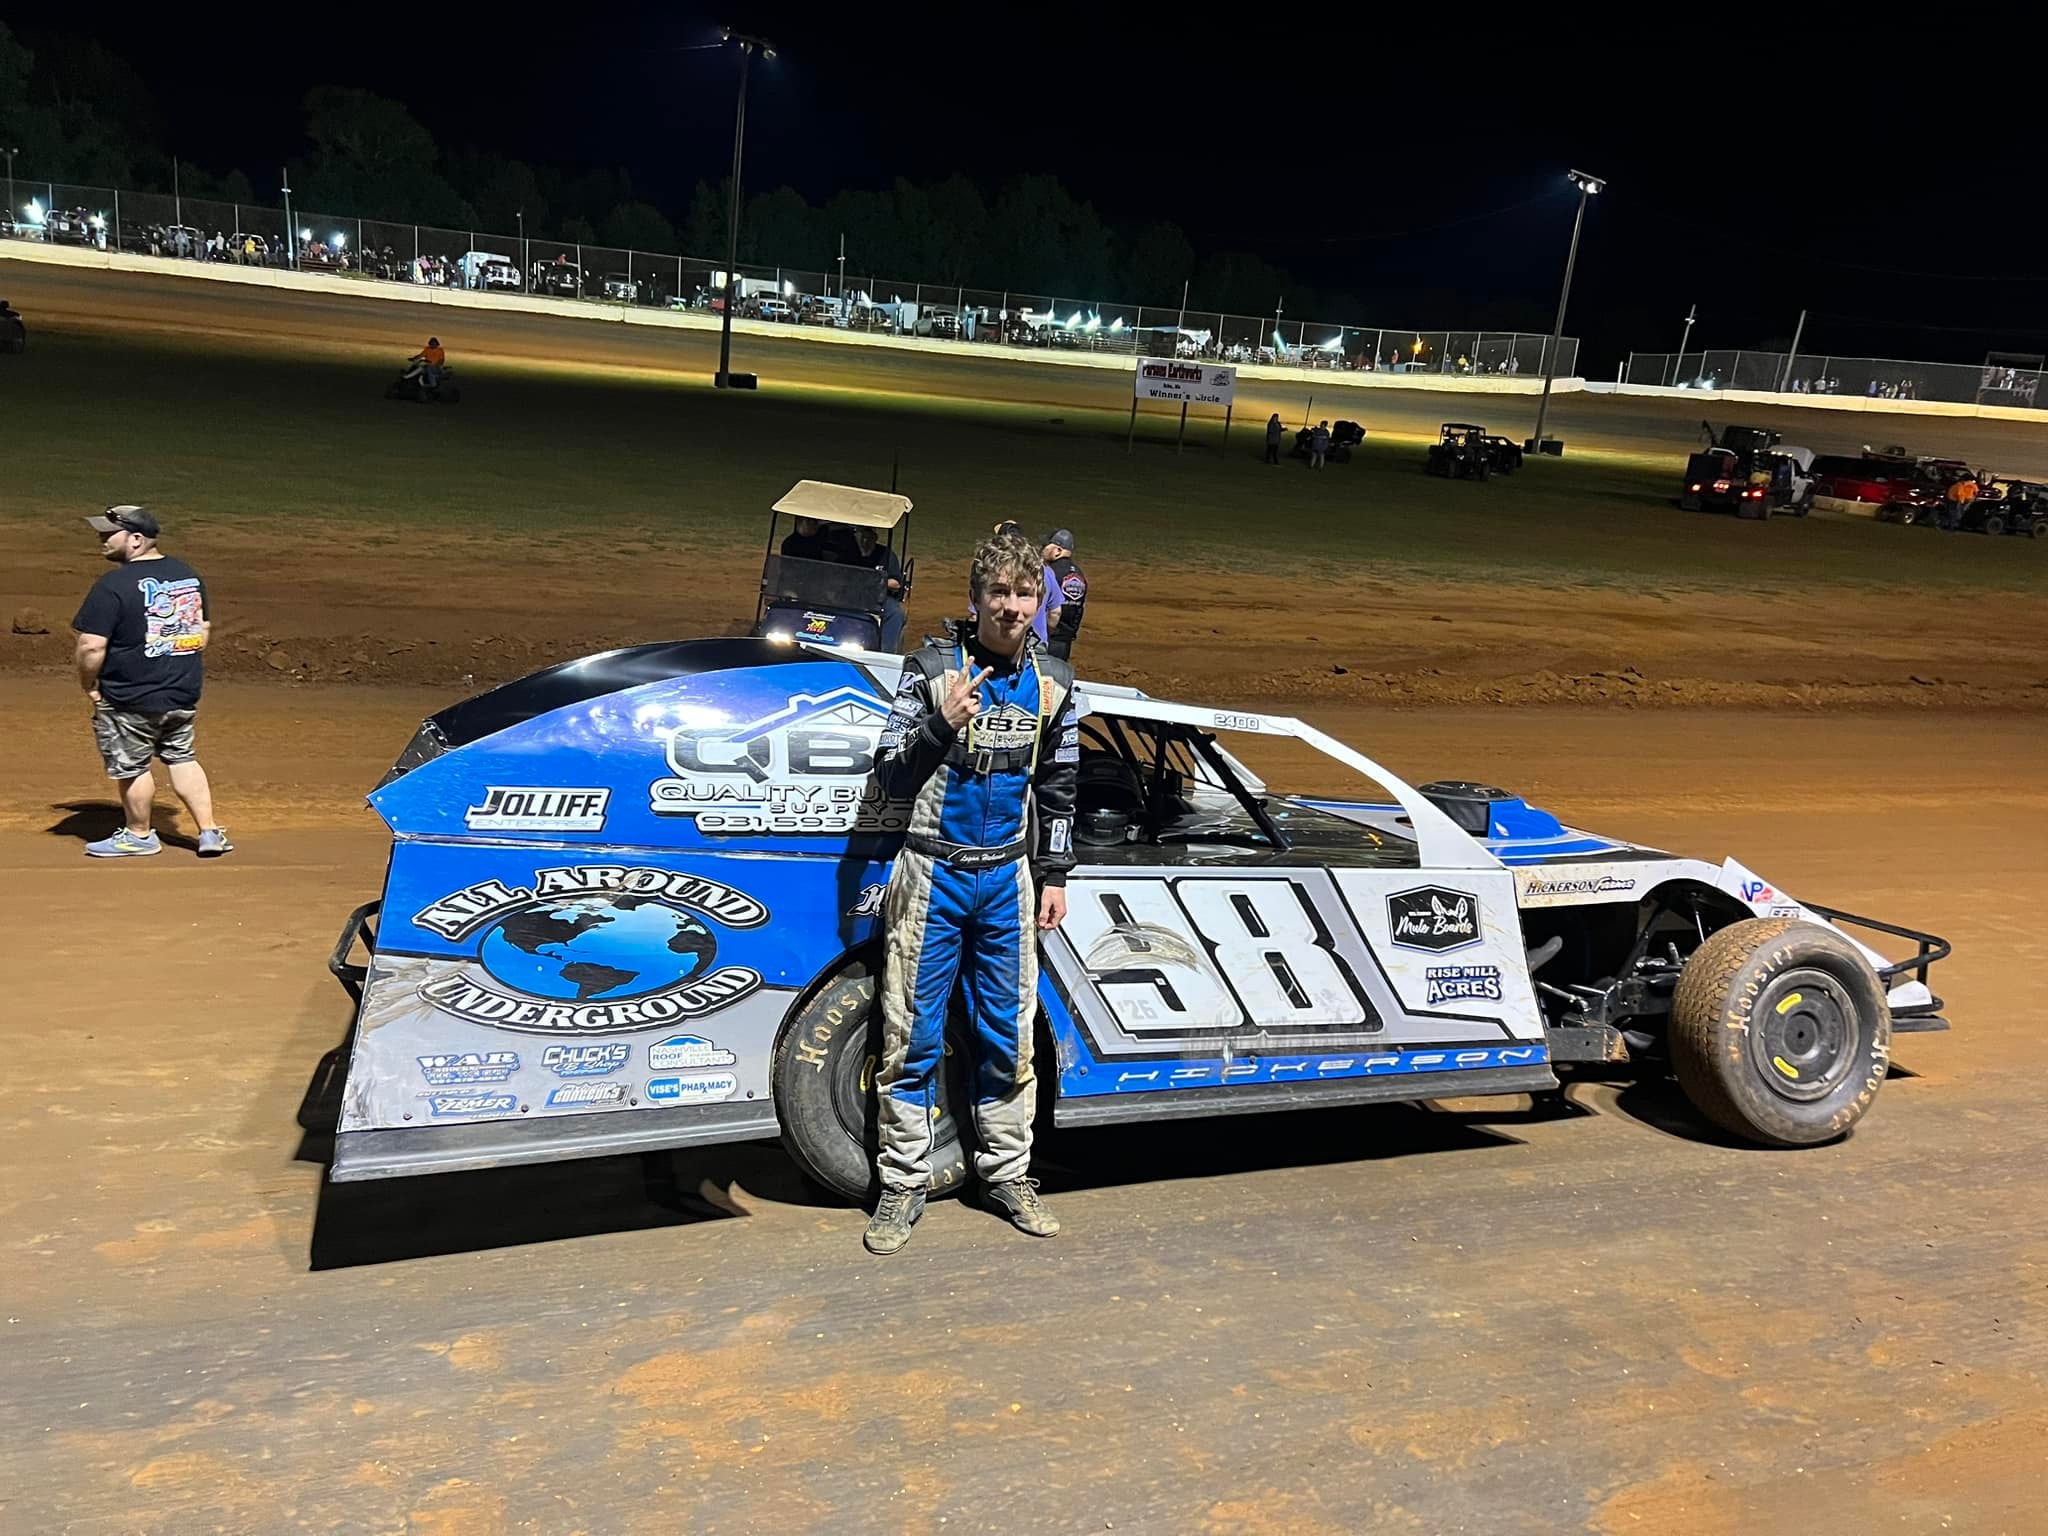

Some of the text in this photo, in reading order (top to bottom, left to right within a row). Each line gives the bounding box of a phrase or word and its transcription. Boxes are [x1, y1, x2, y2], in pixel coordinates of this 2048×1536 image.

[1149, 388, 1191, 401] Winner's
[1214, 713, 1259, 730] 2400
[674, 728, 876, 784] QB
[470, 790, 602, 817] JOLLIFF
[656, 783, 881, 803] QUALITY BU
[769, 802, 887, 815] SUPPLY
[700, 815, 905, 831] 931-593-20
[1742, 881, 1763, 902] VP
[418, 867, 764, 938] ALL AROUND
[1395, 915, 1473, 936] Mule Boards
[1427, 966, 1498, 979] RISE MILL
[430, 967, 758, 1029] UNDERGROUND
[1427, 976, 1500, 1002] ACRES
[795, 984, 871, 1073] HOOSI
[543, 1045, 627, 1066] CHUCK'S
[649, 1084, 679, 1094] VISE'S
